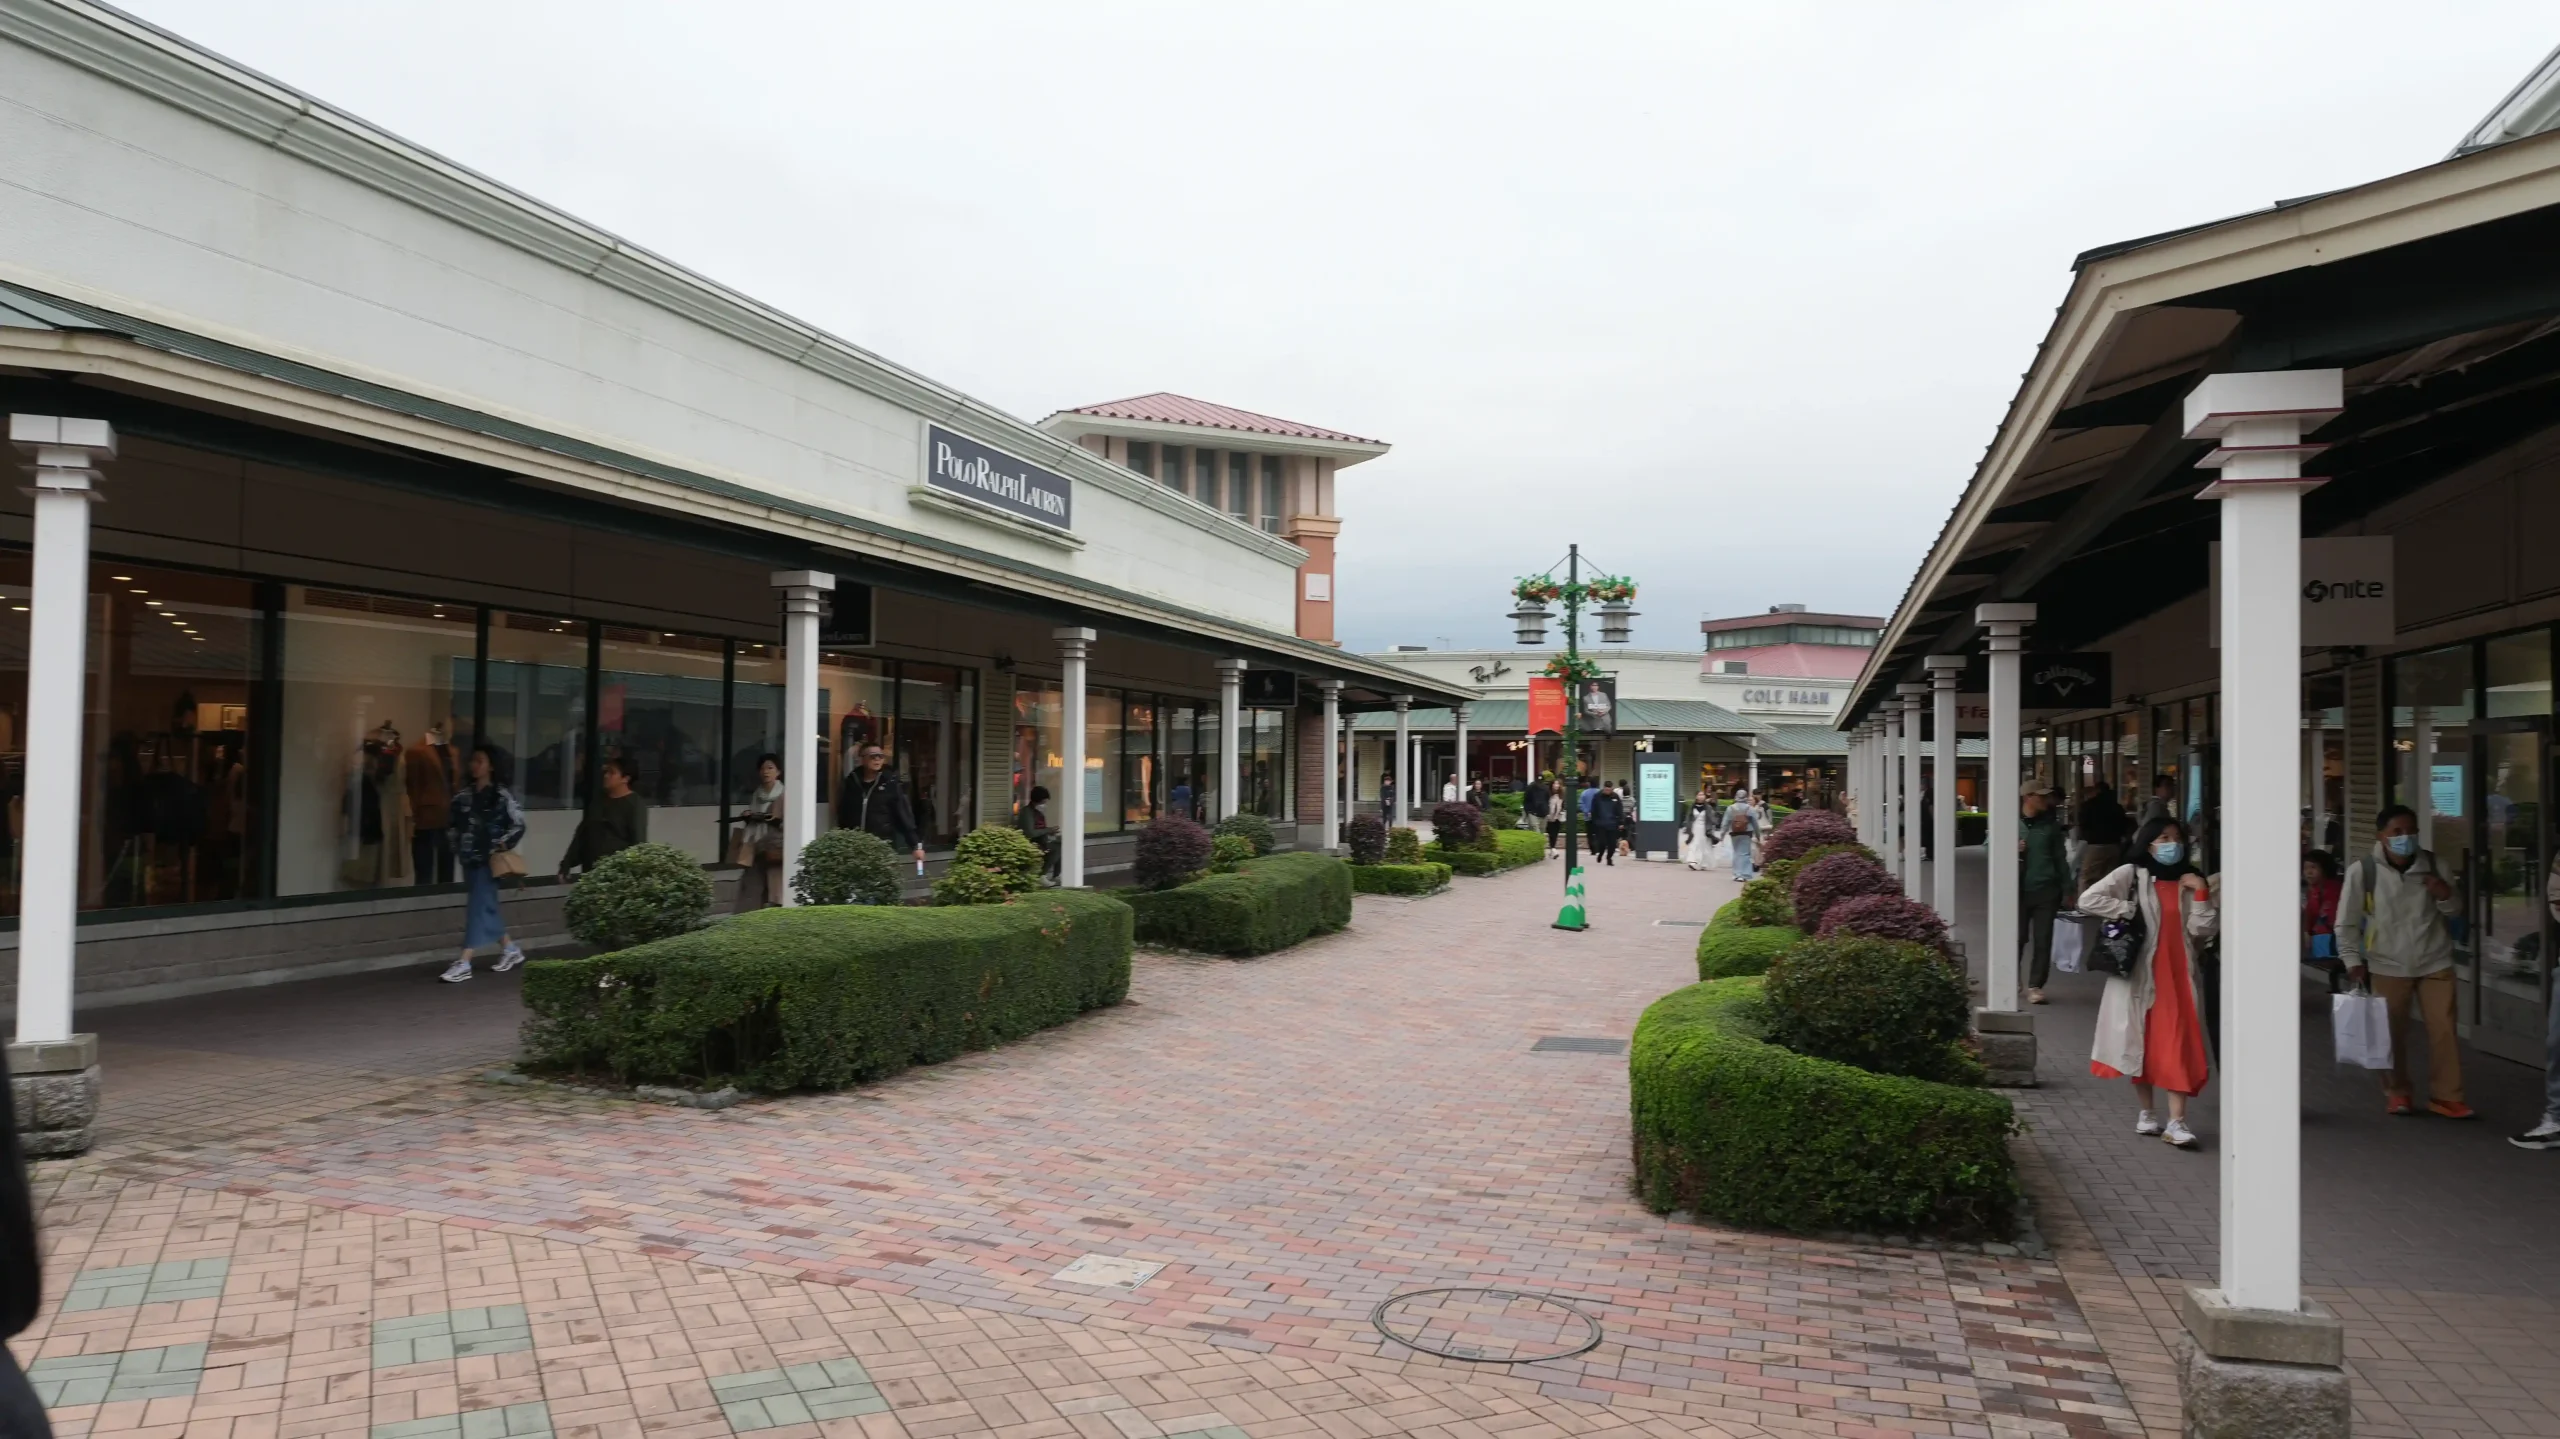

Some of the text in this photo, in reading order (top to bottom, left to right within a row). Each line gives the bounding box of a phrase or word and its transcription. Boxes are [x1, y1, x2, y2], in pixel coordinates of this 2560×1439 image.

[2033, 664, 2096, 685] Callaway
[1742, 688, 1830, 705] COLE HAAN
[1955, 705, 1989, 719] T-fa
